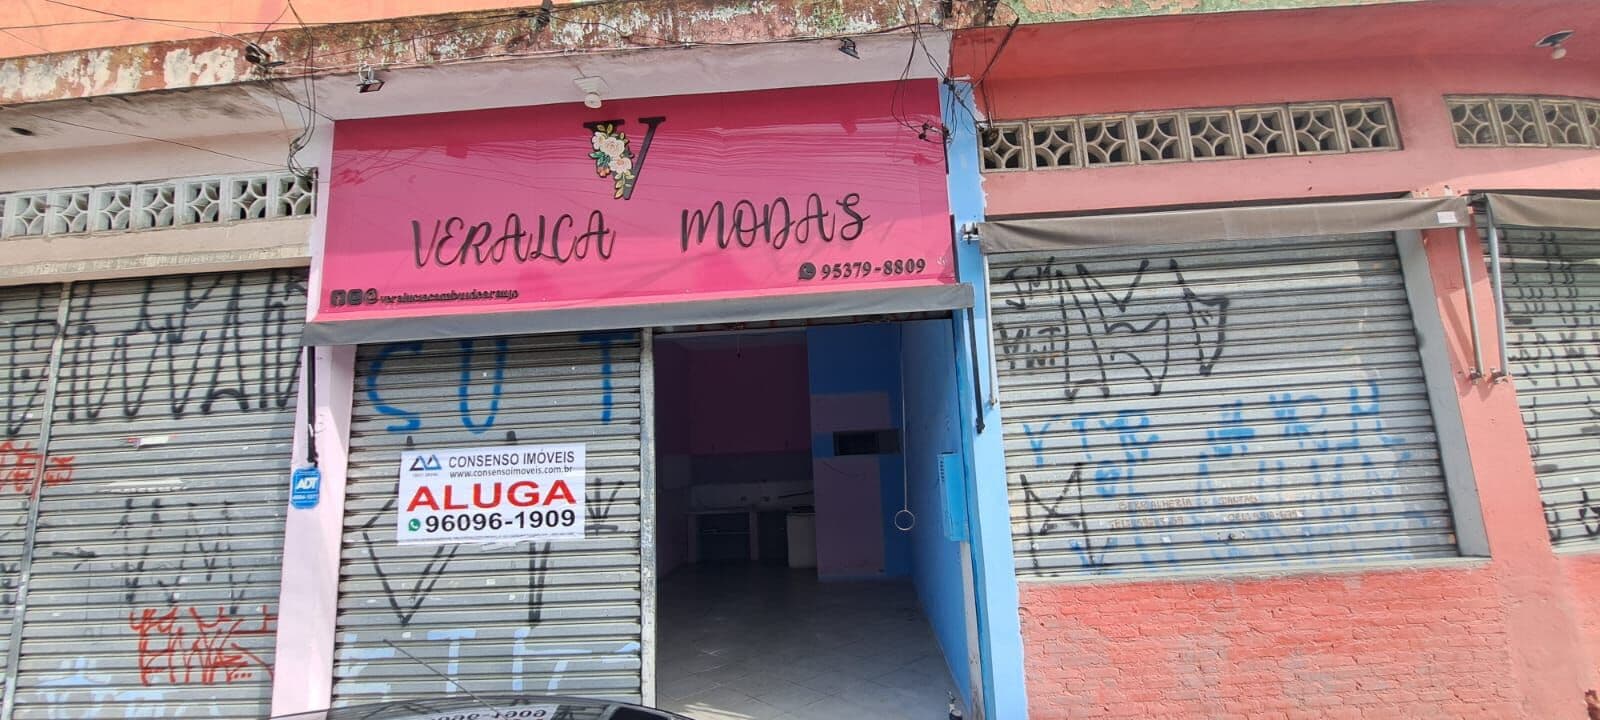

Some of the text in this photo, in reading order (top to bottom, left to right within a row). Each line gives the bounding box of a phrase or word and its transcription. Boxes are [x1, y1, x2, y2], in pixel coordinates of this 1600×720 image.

[583, 116, 666, 200] V
[411, 193, 871, 268] VERALCA MODAS
[821, 258, 926, 280] 95379-8809
[449, 450, 575, 468] CONSENSO IMÓVEIS
[294, 474, 319, 489] ADT
[450, 466, 573, 479] www.consensoimoveis.com.br
[407, 480, 577, 512] ALUGA
[425, 509, 576, 533] 96096-1909
